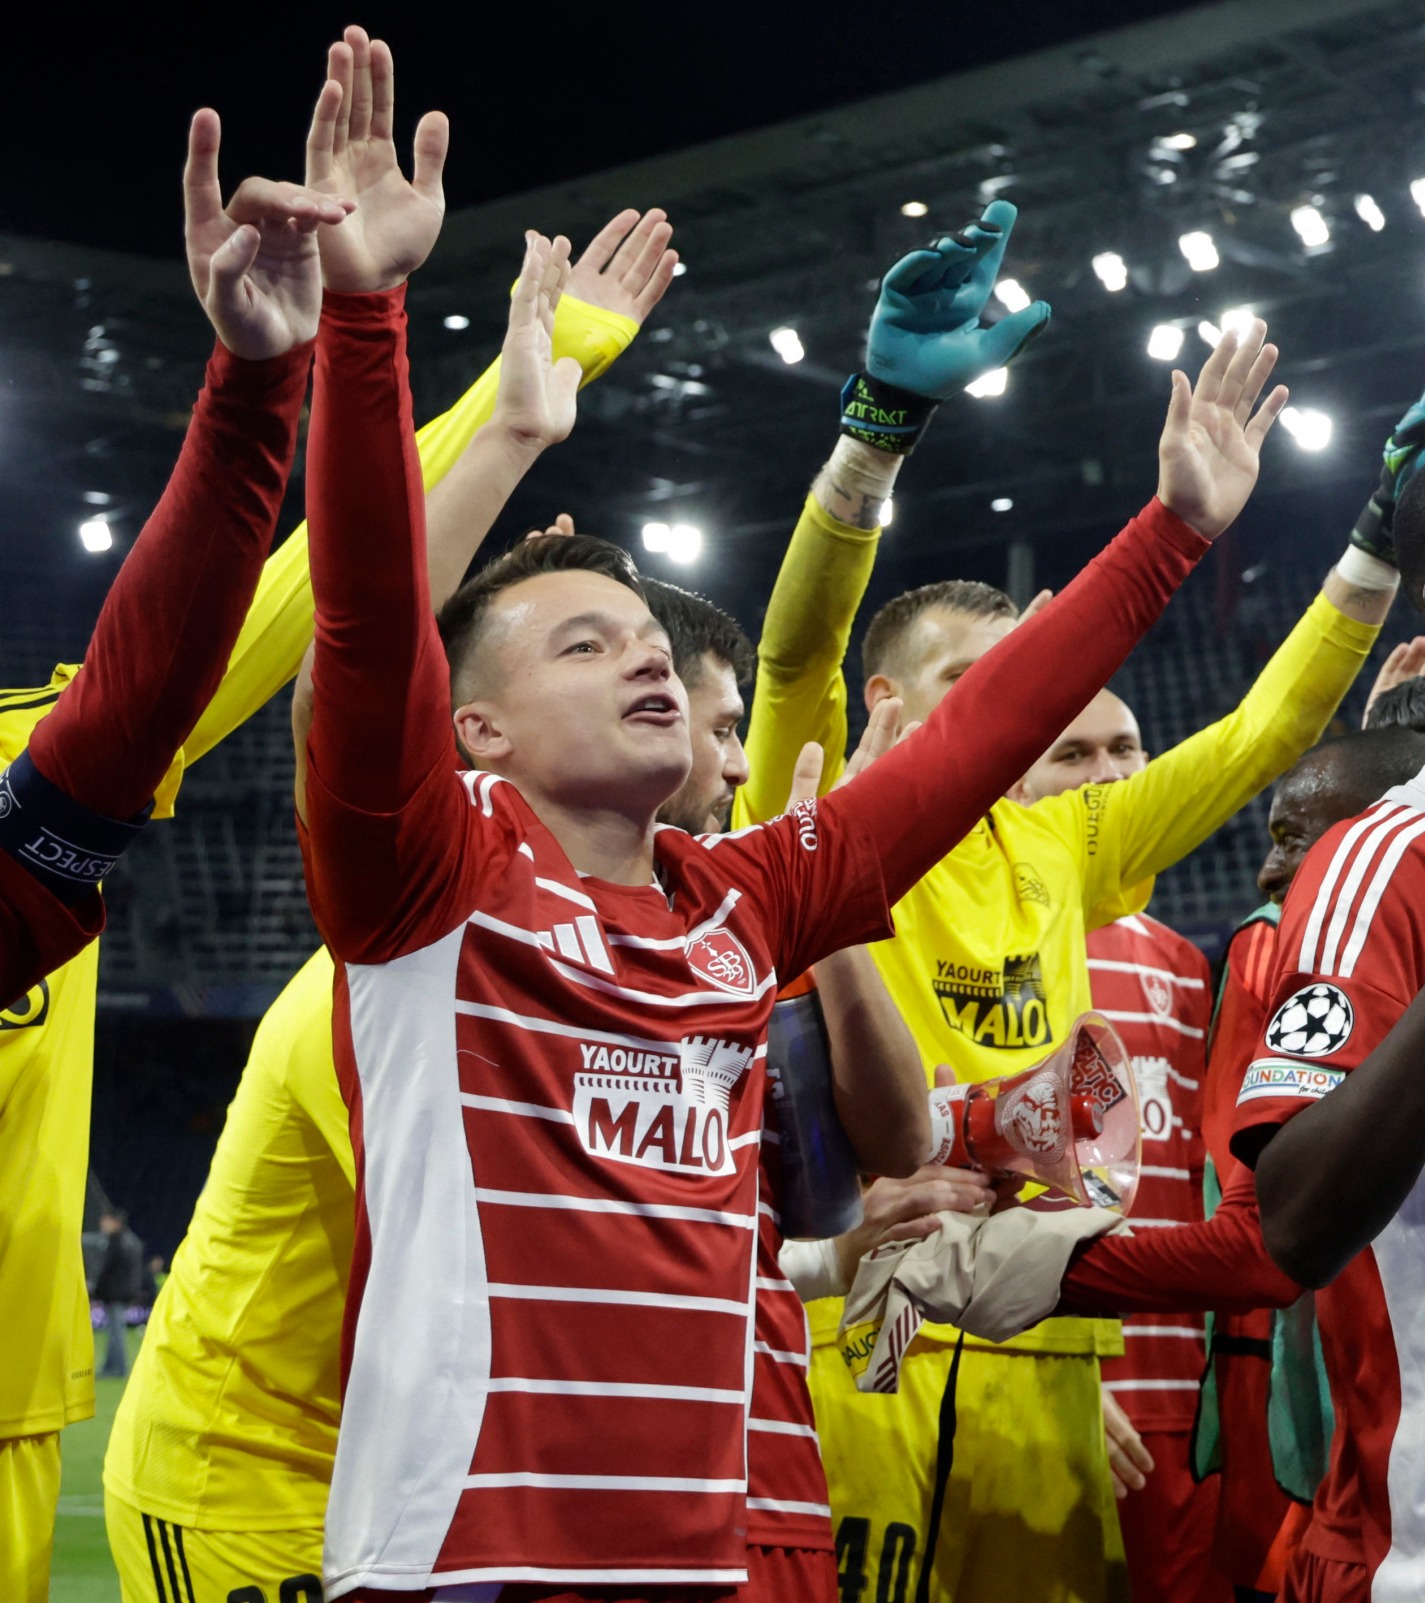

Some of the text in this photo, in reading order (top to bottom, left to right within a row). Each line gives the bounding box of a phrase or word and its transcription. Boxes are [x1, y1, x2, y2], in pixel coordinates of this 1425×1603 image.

[25, 836, 116, 876] ESPECT
[937, 959, 1002, 984] YAOURT
[940, 996, 1047, 1046] MALO
[579, 1043, 679, 1077] YAOURT
[588, 1096, 726, 1172] MALO
